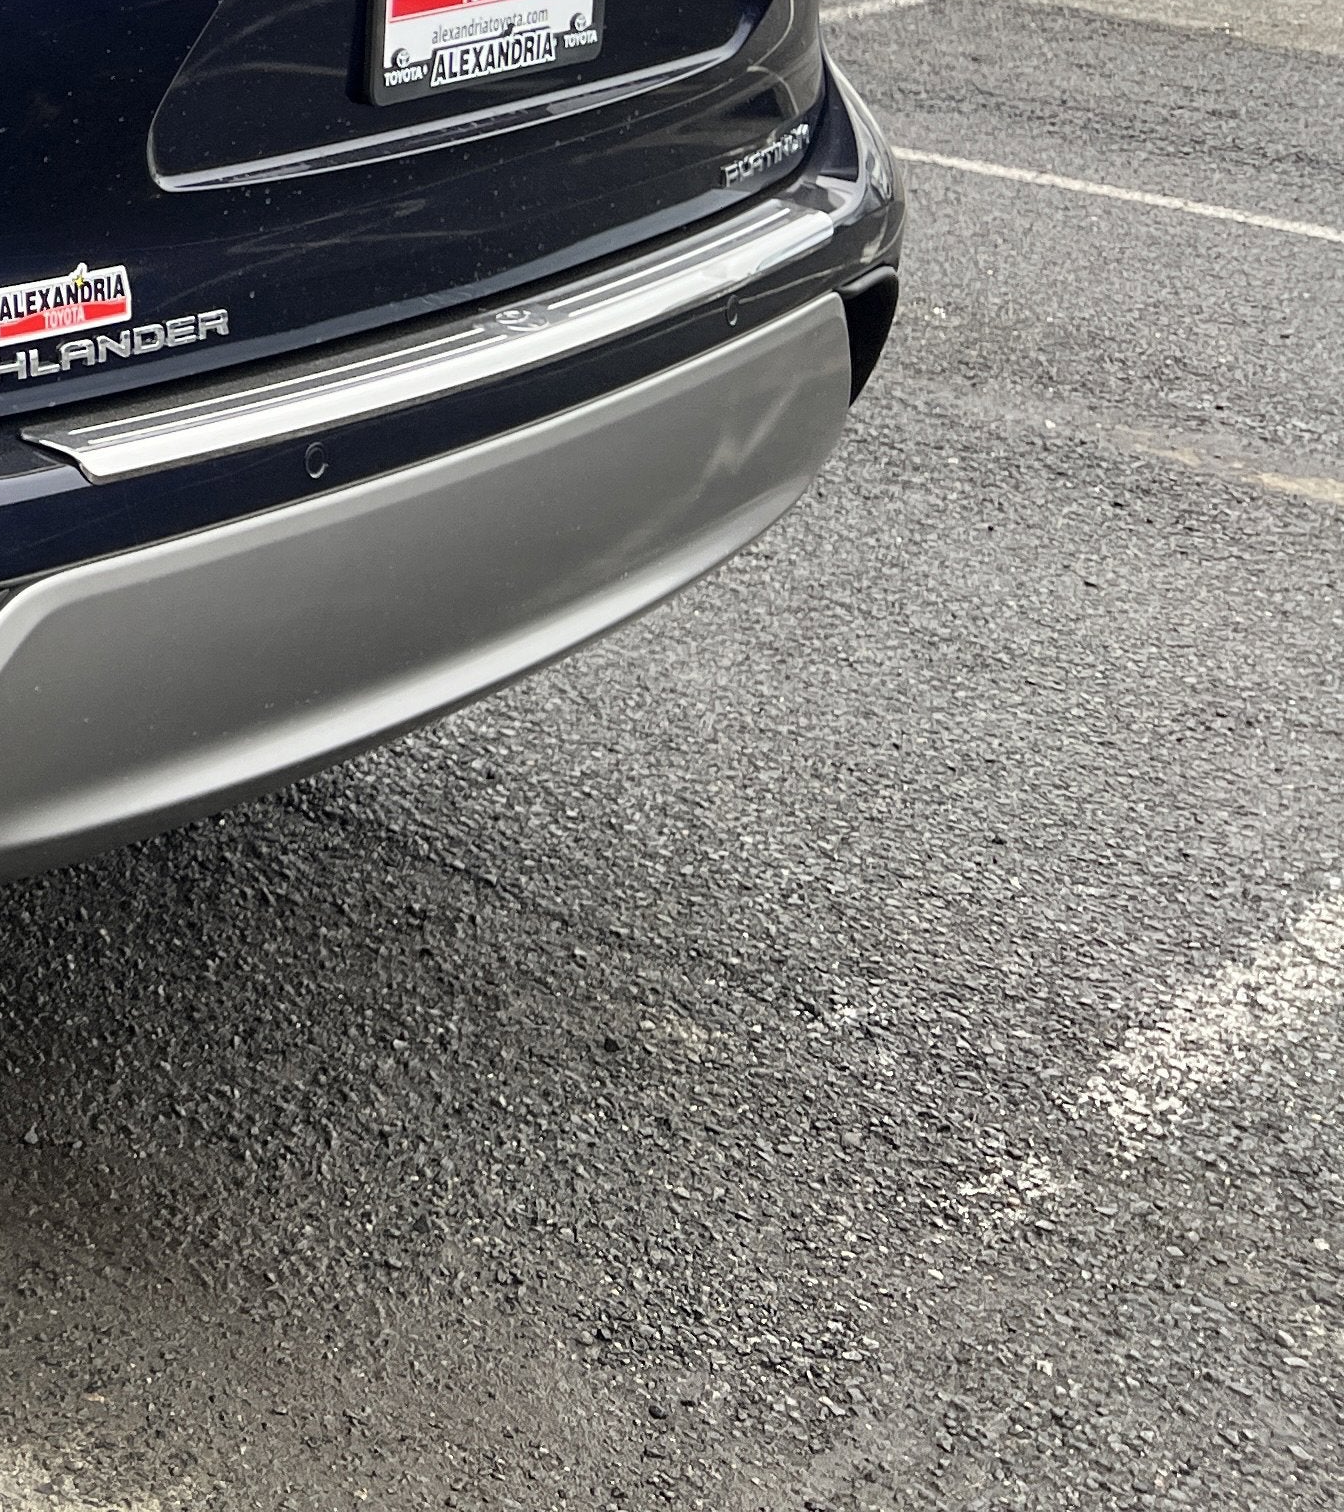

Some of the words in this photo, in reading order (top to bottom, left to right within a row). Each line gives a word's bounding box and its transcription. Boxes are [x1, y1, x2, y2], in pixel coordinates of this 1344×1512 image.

[431, 8, 548, 44] alexandriatoyota.com
[384, 65, 424, 87] TOYOTA
[434, 32, 554, 83] ALEXANDRIA
[564, 29, 598, 49] TOYOTA
[43, 305, 85, 328] TOYOTA
